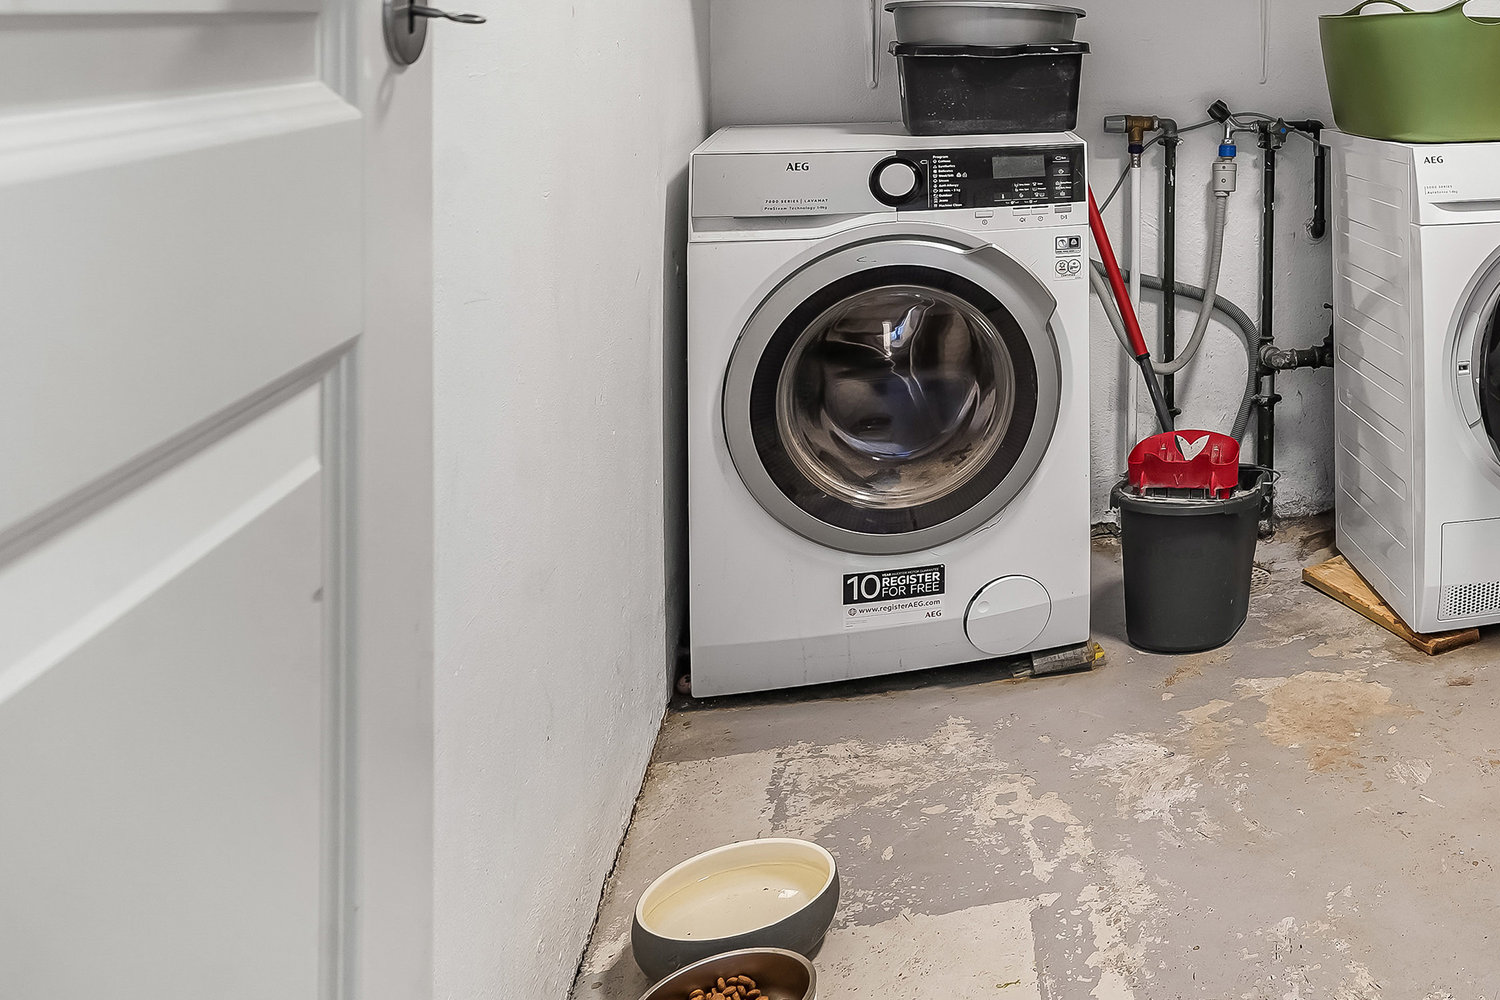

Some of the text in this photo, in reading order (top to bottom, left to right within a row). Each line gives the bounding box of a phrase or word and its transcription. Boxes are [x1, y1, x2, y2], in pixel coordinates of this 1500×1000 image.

[785, 162, 809, 172] AEG
[1423, 155, 1444, 165] AEG
[847, 574, 881, 601] 10
[882, 572, 940, 588] REGISTER
[882, 581, 940, 597] FOR FREE
[859, 599, 941, 614] www.registerAEG.com
[925, 610, 942, 619] AEG
